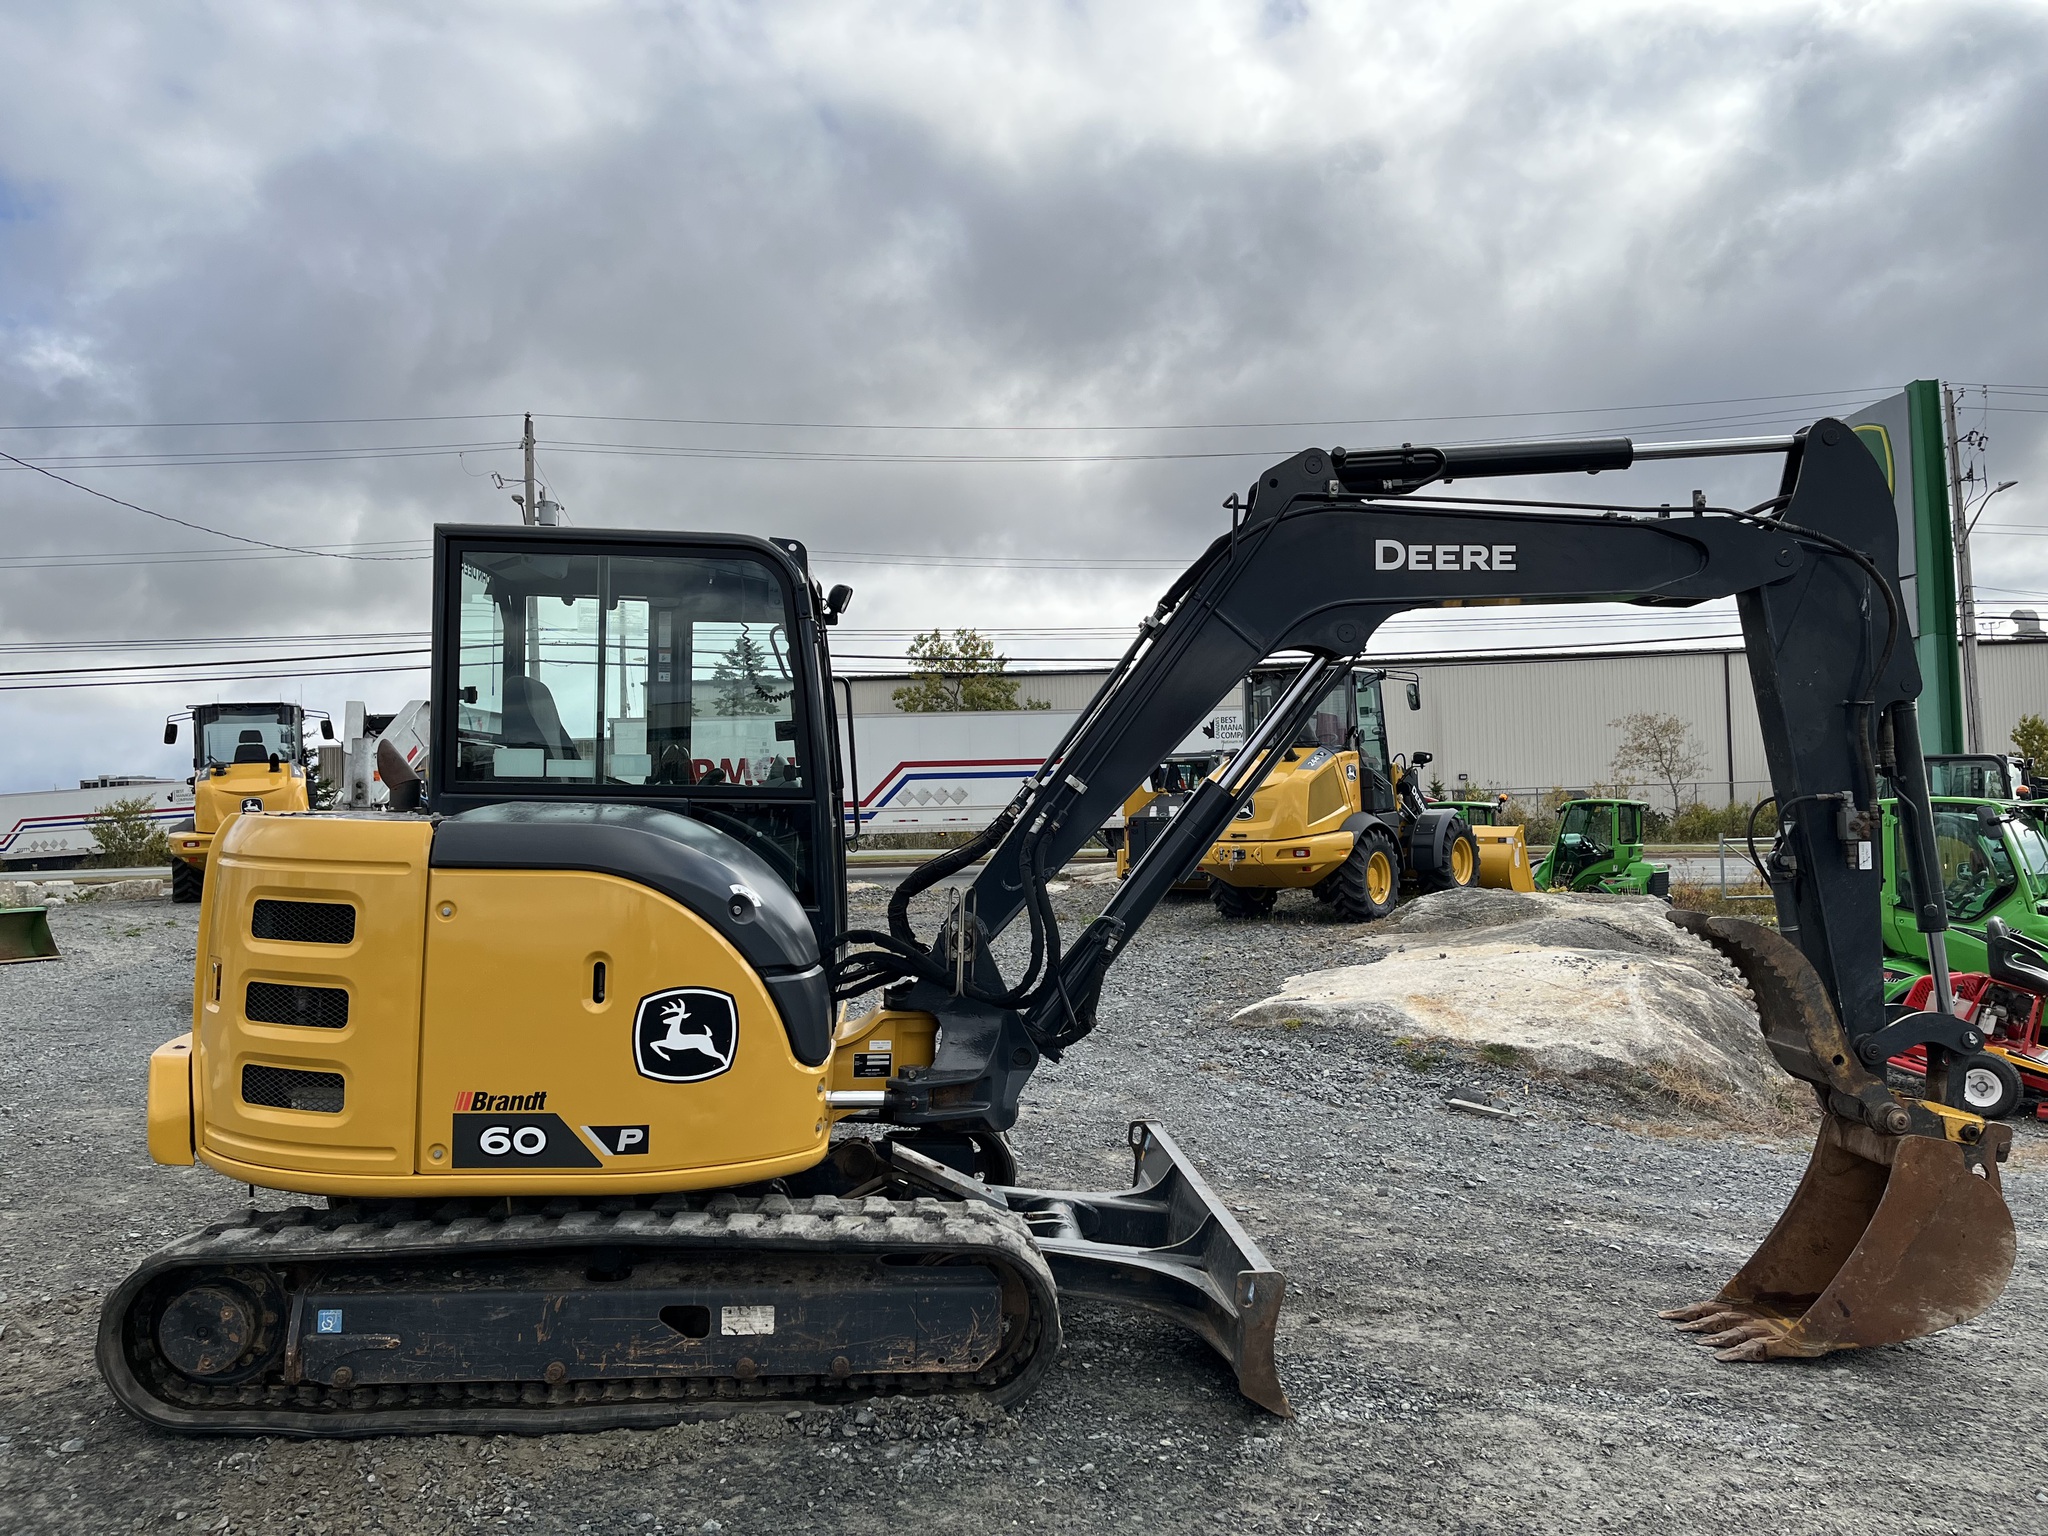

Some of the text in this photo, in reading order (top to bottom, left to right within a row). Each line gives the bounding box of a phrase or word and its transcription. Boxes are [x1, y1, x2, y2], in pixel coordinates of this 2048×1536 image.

[1375, 539, 1517, 571] DEERE
[1220, 723, 1243, 731] MANA
[470, 1091, 548, 1112] Brandt
[479, 1126, 644, 1155] 60 P
